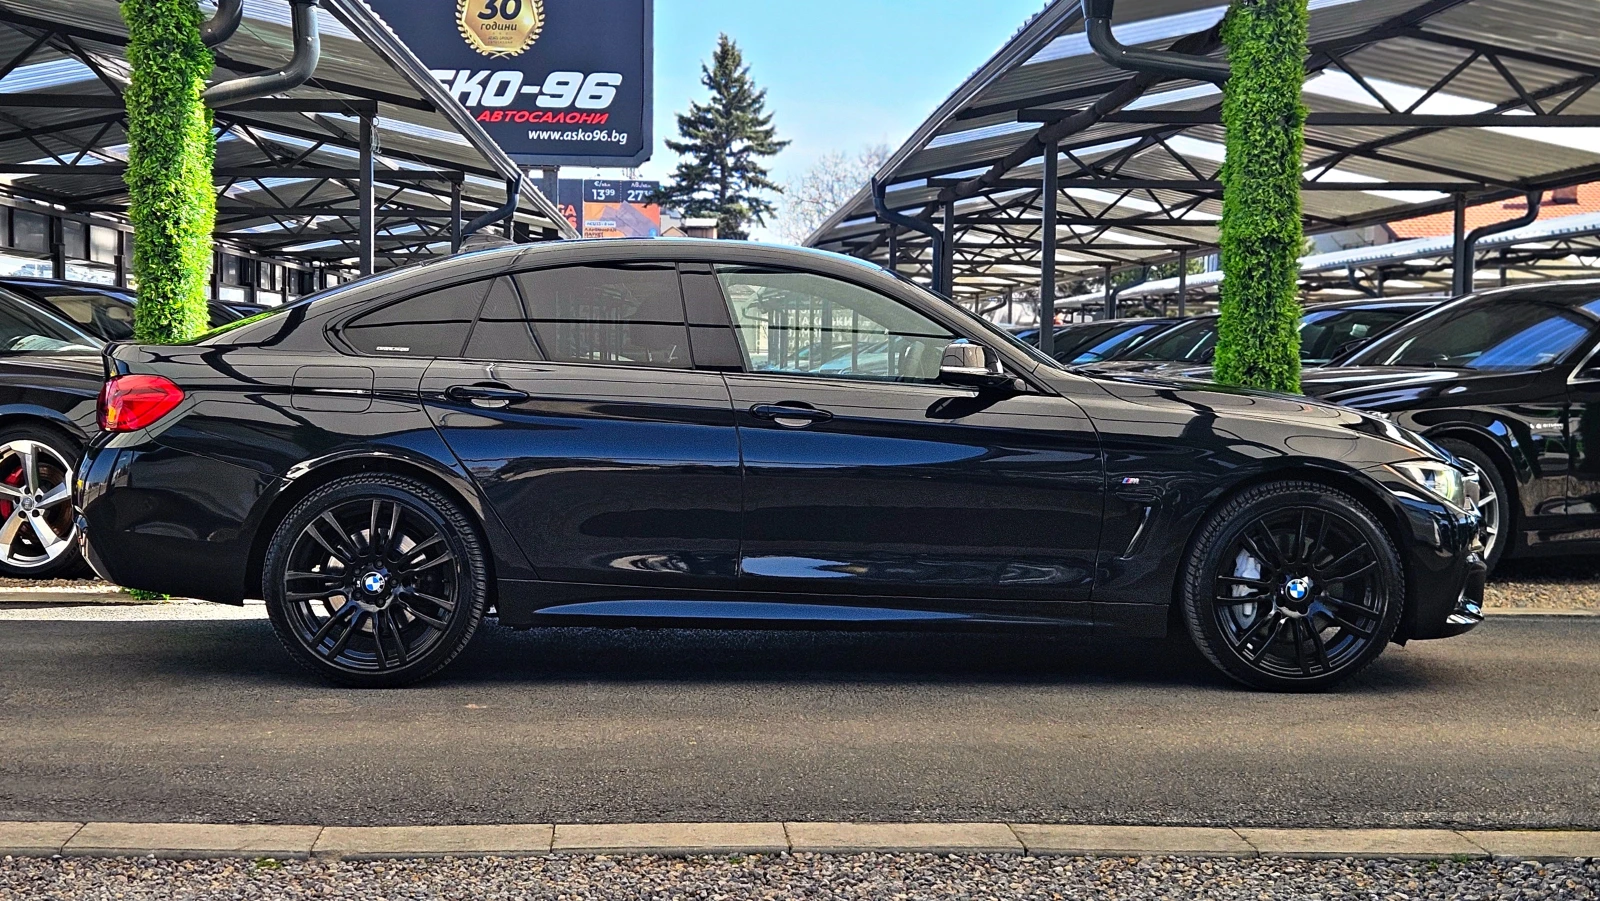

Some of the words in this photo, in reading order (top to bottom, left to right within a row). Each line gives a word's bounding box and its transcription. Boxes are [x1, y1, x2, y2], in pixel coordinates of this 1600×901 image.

[477, 0, 522, 20] 30
[480, 21, 517, 31] години
[477, 110, 609, 125] АВТОСАЛОНИ
[528, 129, 628, 144] www.asko96.bg
